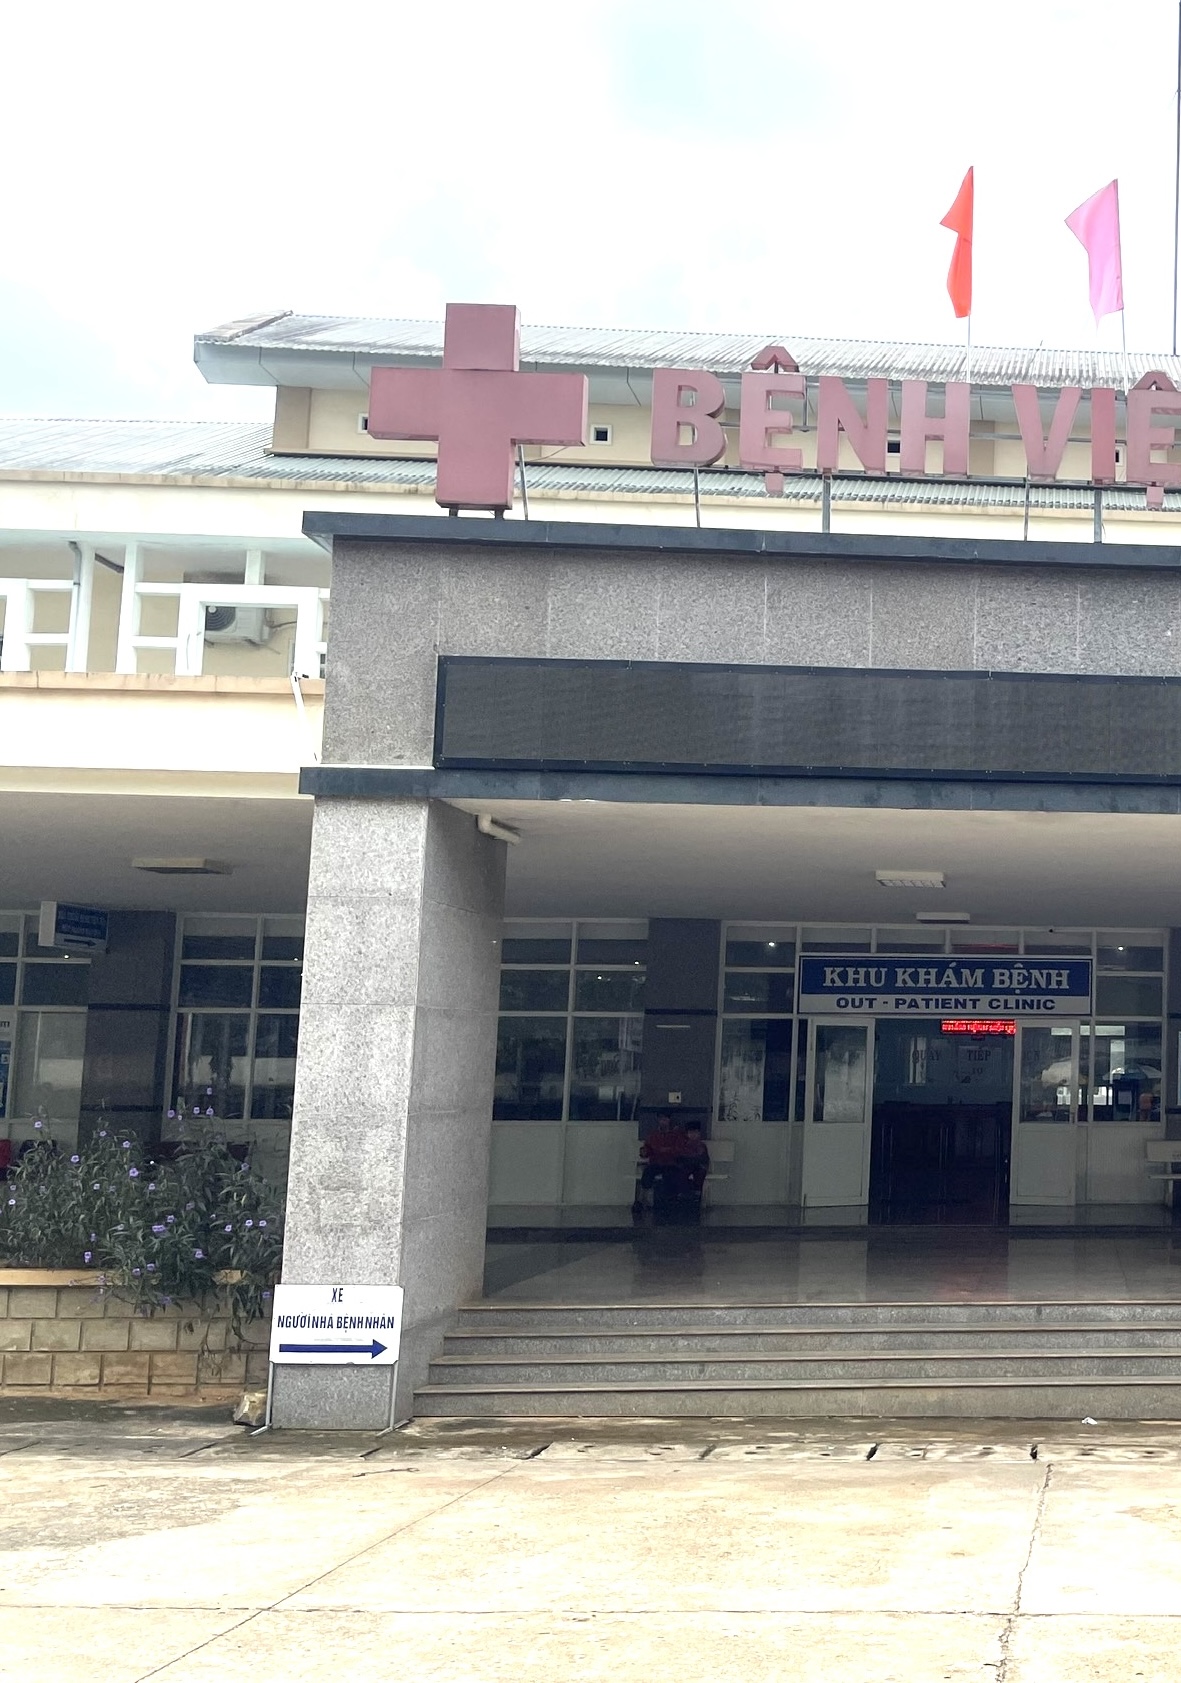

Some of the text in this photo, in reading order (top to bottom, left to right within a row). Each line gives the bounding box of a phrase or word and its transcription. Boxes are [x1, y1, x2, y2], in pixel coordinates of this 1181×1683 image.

[650, 345, 969, 495] BỆNH
[823, 962, 1070, 994] KHU KHÁM BỆNH
[836, 997, 877, 1009] OUT
[894, 997, 980, 1010] PATIENT
[988, 998, 1056, 1011] CLINIC
[331, 1288, 344, 1302] XE
